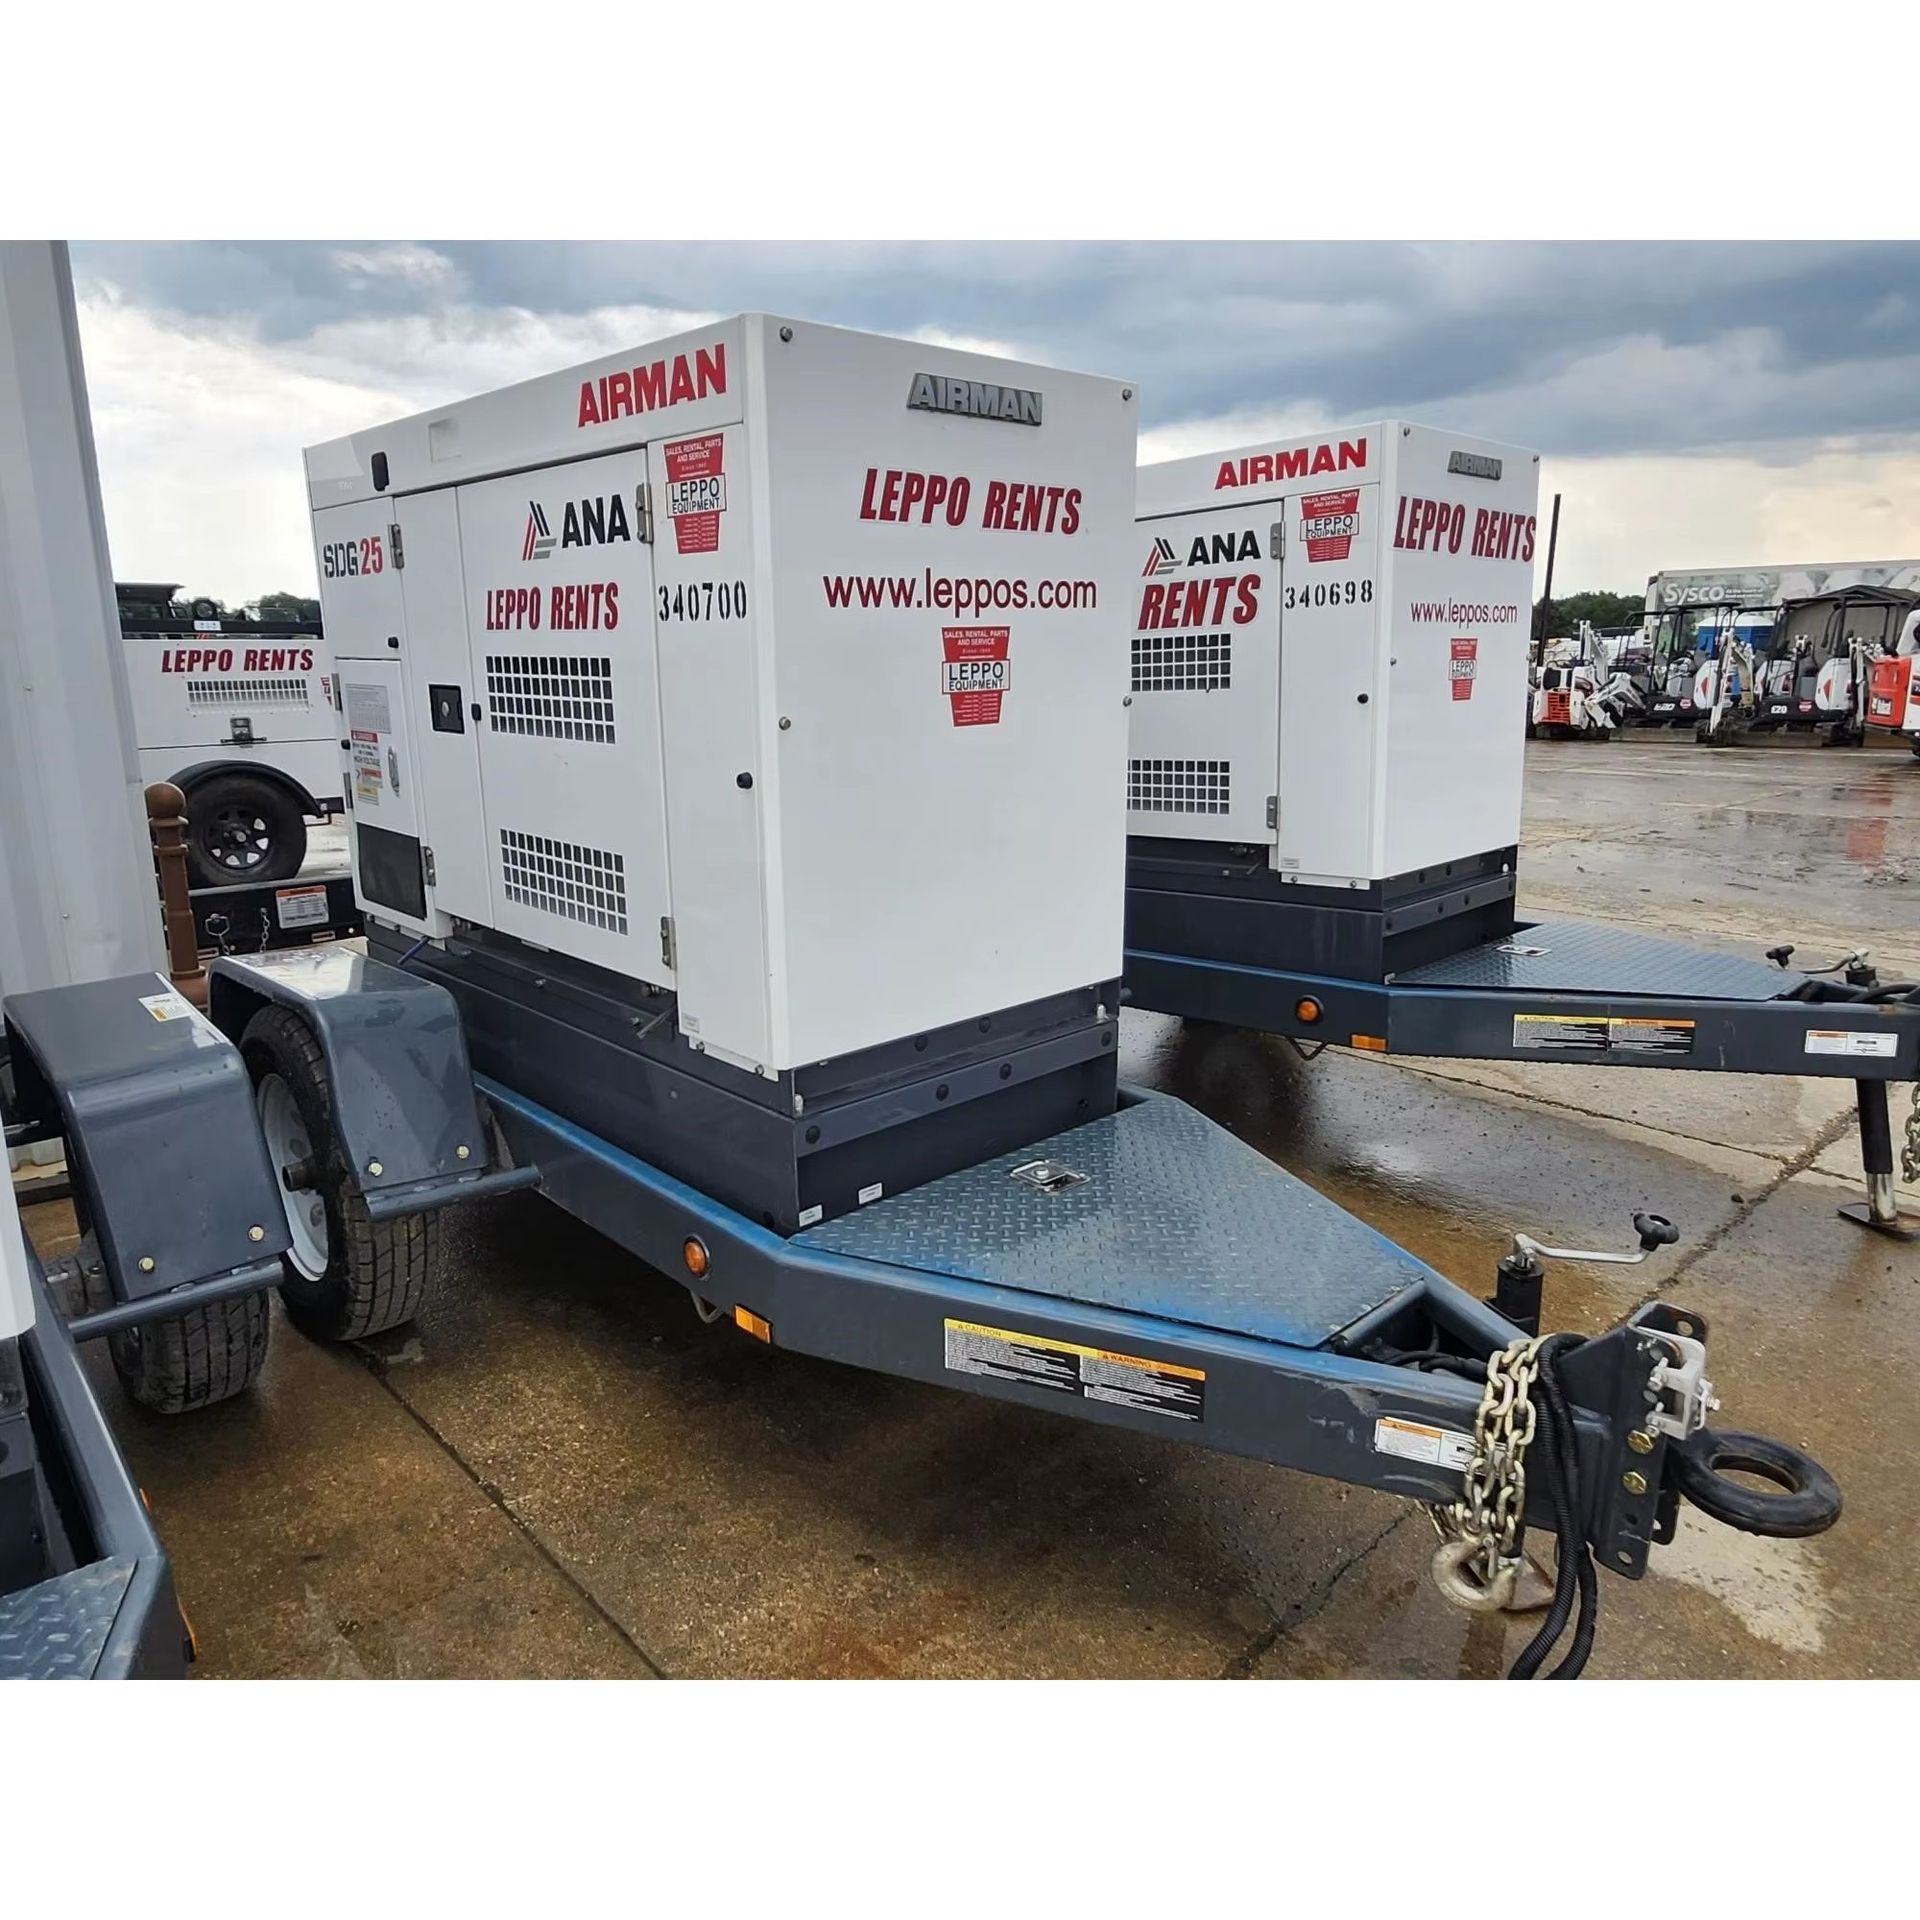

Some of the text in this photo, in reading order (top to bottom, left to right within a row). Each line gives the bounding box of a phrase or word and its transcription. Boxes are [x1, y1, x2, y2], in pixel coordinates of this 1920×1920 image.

[579, 343, 727, 428] AIRMAN
[907, 373, 1042, 426] AIRMAN
[677, 450, 710, 463] AND SERVICE
[705, 438, 722, 448] PARTS
[1215, 438, 1367, 490] AIRMAN
[1448, 451, 1502, 480] AIRMAN
[671, 477, 720, 503] LEPPO
[860, 468, 1082, 535] LEPPO RENTS
[672, 497, 720, 514] EQUIPMENT
[562, 494, 631, 549] ANA
[1305, 515, 1353, 532] LEPPO
[1305, 527, 1353, 539] EQUIPMENT
[1393, 496, 1537, 563] LEPPO RENTS
[323, 536, 383, 579] SDG25
[1187, 530, 1261, 567] ANA
[487, 582, 618, 630] LEPPO RENTS
[658, 580, 747, 621] 340700
[823, 568, 1096, 618] www.leppos.com
[1138, 573, 1261, 630] RENTS
[1284, 580, 1373, 609] 340698
[1411, 598, 1518, 628] www.leppos.com
[958, 638, 970, 646] AND
[990, 630, 1008, 638] PARTS
[161, 648, 314, 673] LEPPO RENTS
[949, 662, 1004, 680] LEPPO
[1452, 660, 1475, 673] LEPPO
[949, 679, 1003, 691] EQUIPMENT
[965, 1323, 1001, 1338] CAUTION
[1110, 1353, 1152, 1369] WARNING
